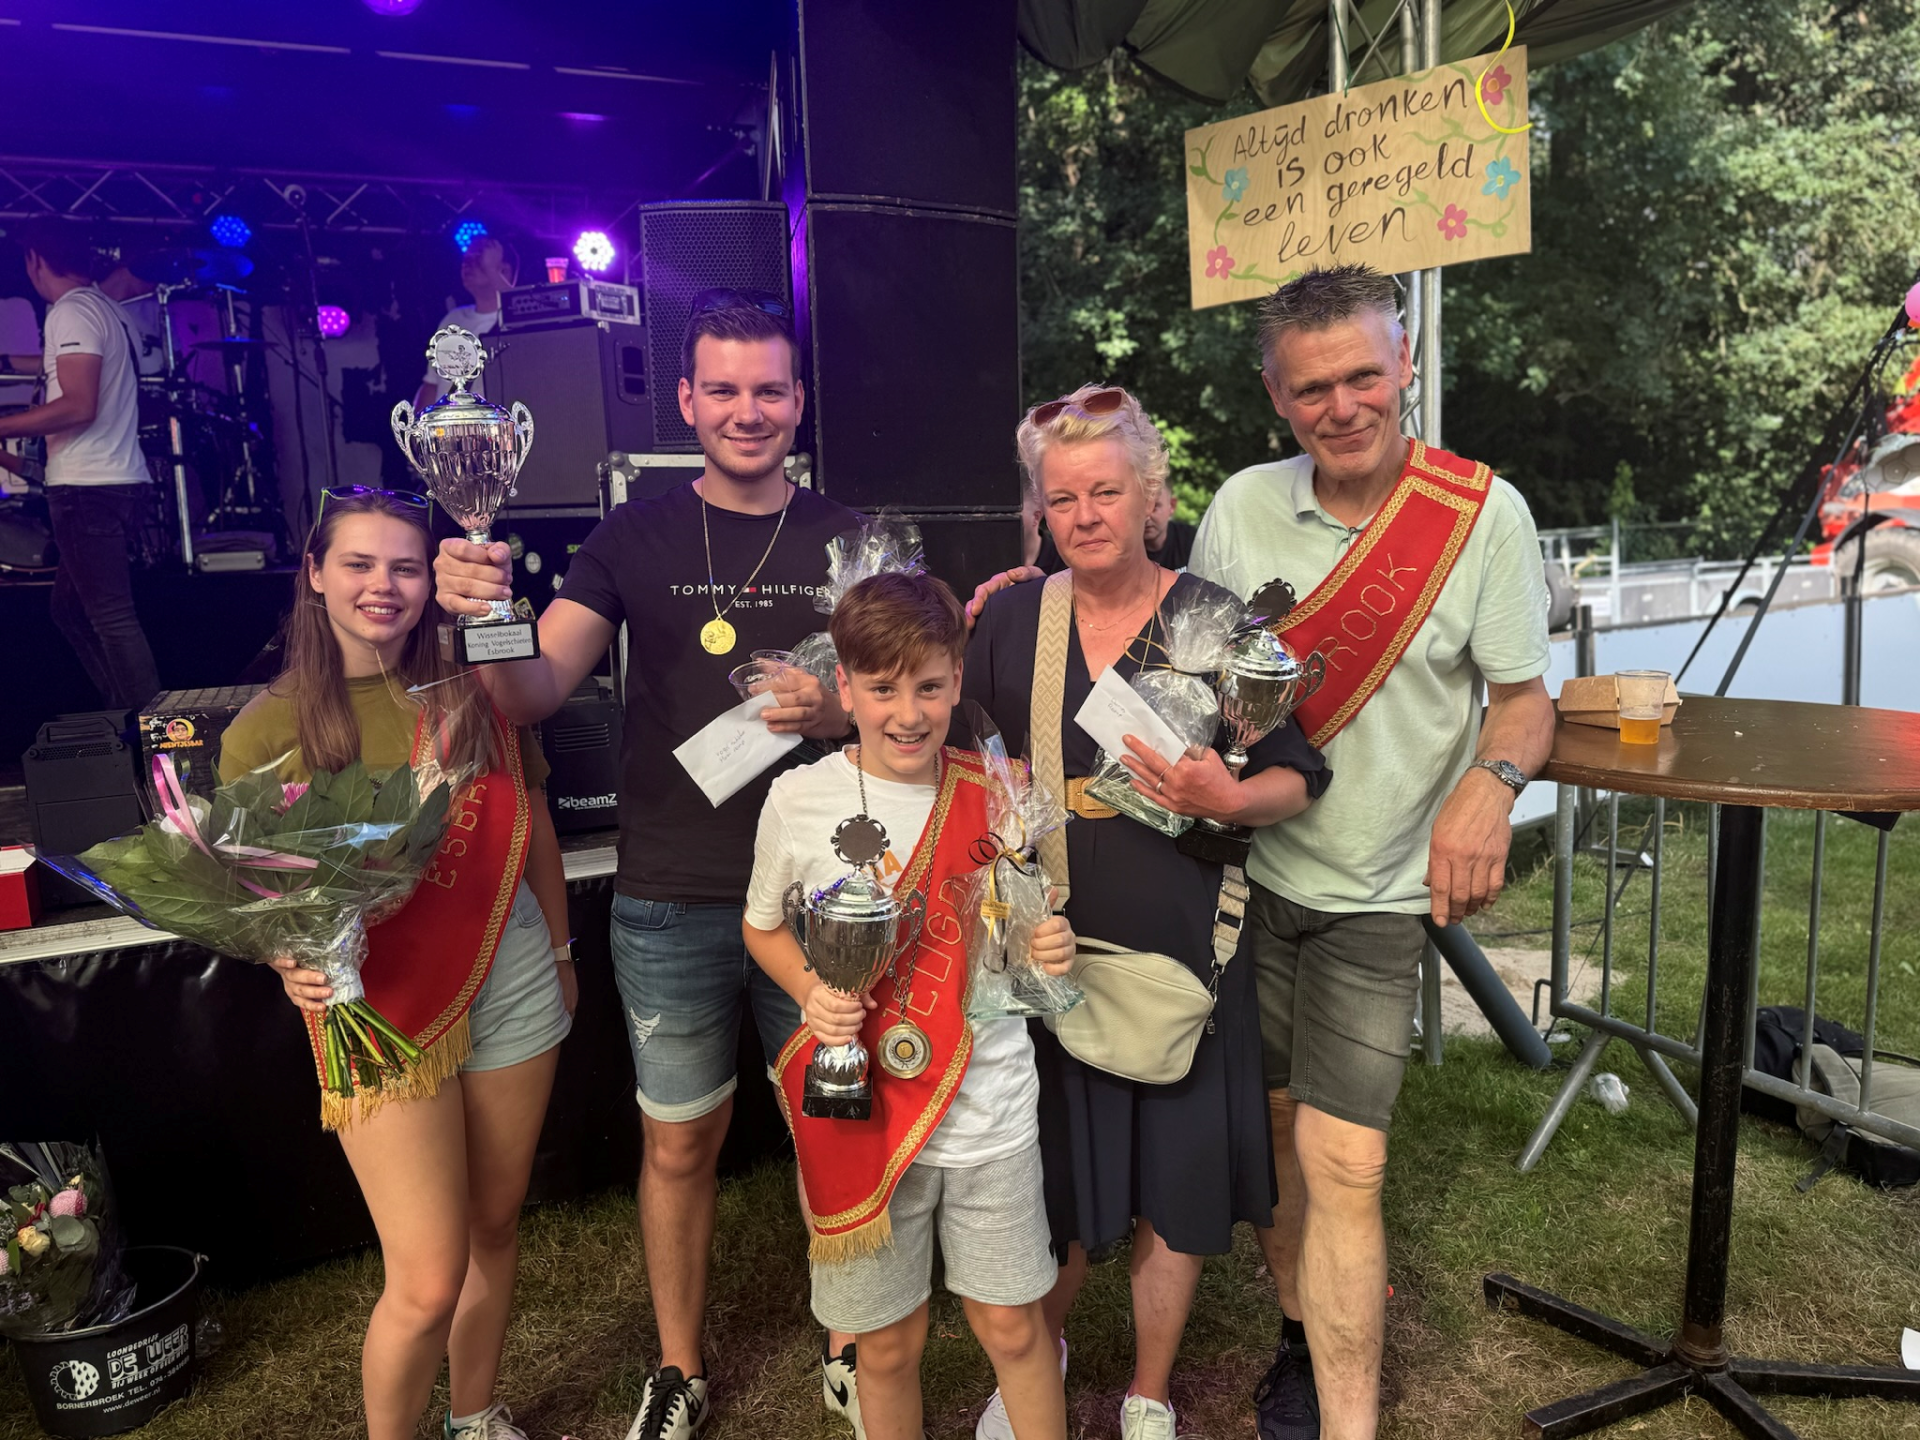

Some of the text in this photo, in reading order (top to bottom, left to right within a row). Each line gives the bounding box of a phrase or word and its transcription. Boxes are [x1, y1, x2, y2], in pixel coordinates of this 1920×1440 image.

[1324, 78, 1467, 138] dronken
[1243, 142, 1475, 226] een geregeld
[1277, 133, 1392, 190] is ook
[1277, 207, 1417, 263] leven
[670, 584, 832, 598] TOMMY HILFIGER
[734, 599, 774, 609] EST. 1985
[1300, 552, 1417, 688] ROOK
[487, 647, 515, 656] Esbrook
[425, 763, 490, 889] ESBR
[107, 1323, 189, 1380] DE WEER
[56, 1391, 125, 1411] BORNERBROEK
[127, 1383, 148, 1396] TEL.
